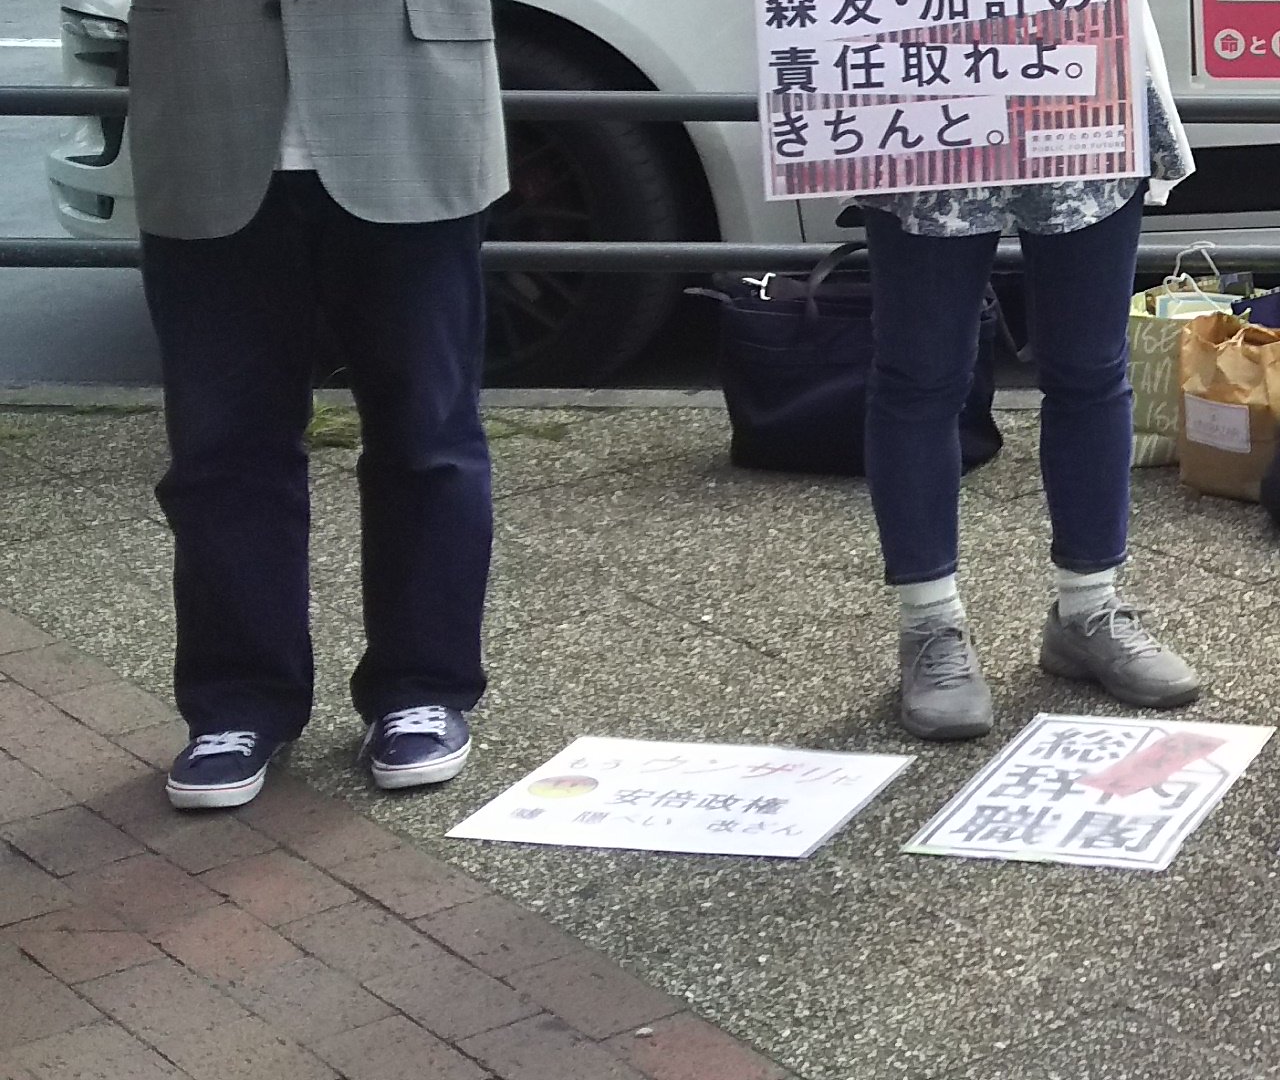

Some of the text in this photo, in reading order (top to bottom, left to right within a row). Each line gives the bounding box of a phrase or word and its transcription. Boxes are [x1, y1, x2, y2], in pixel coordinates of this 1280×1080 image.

[768, 38, 1084, 96] 責任取れよ。
[771, 103, 1006, 159] きちんと。
